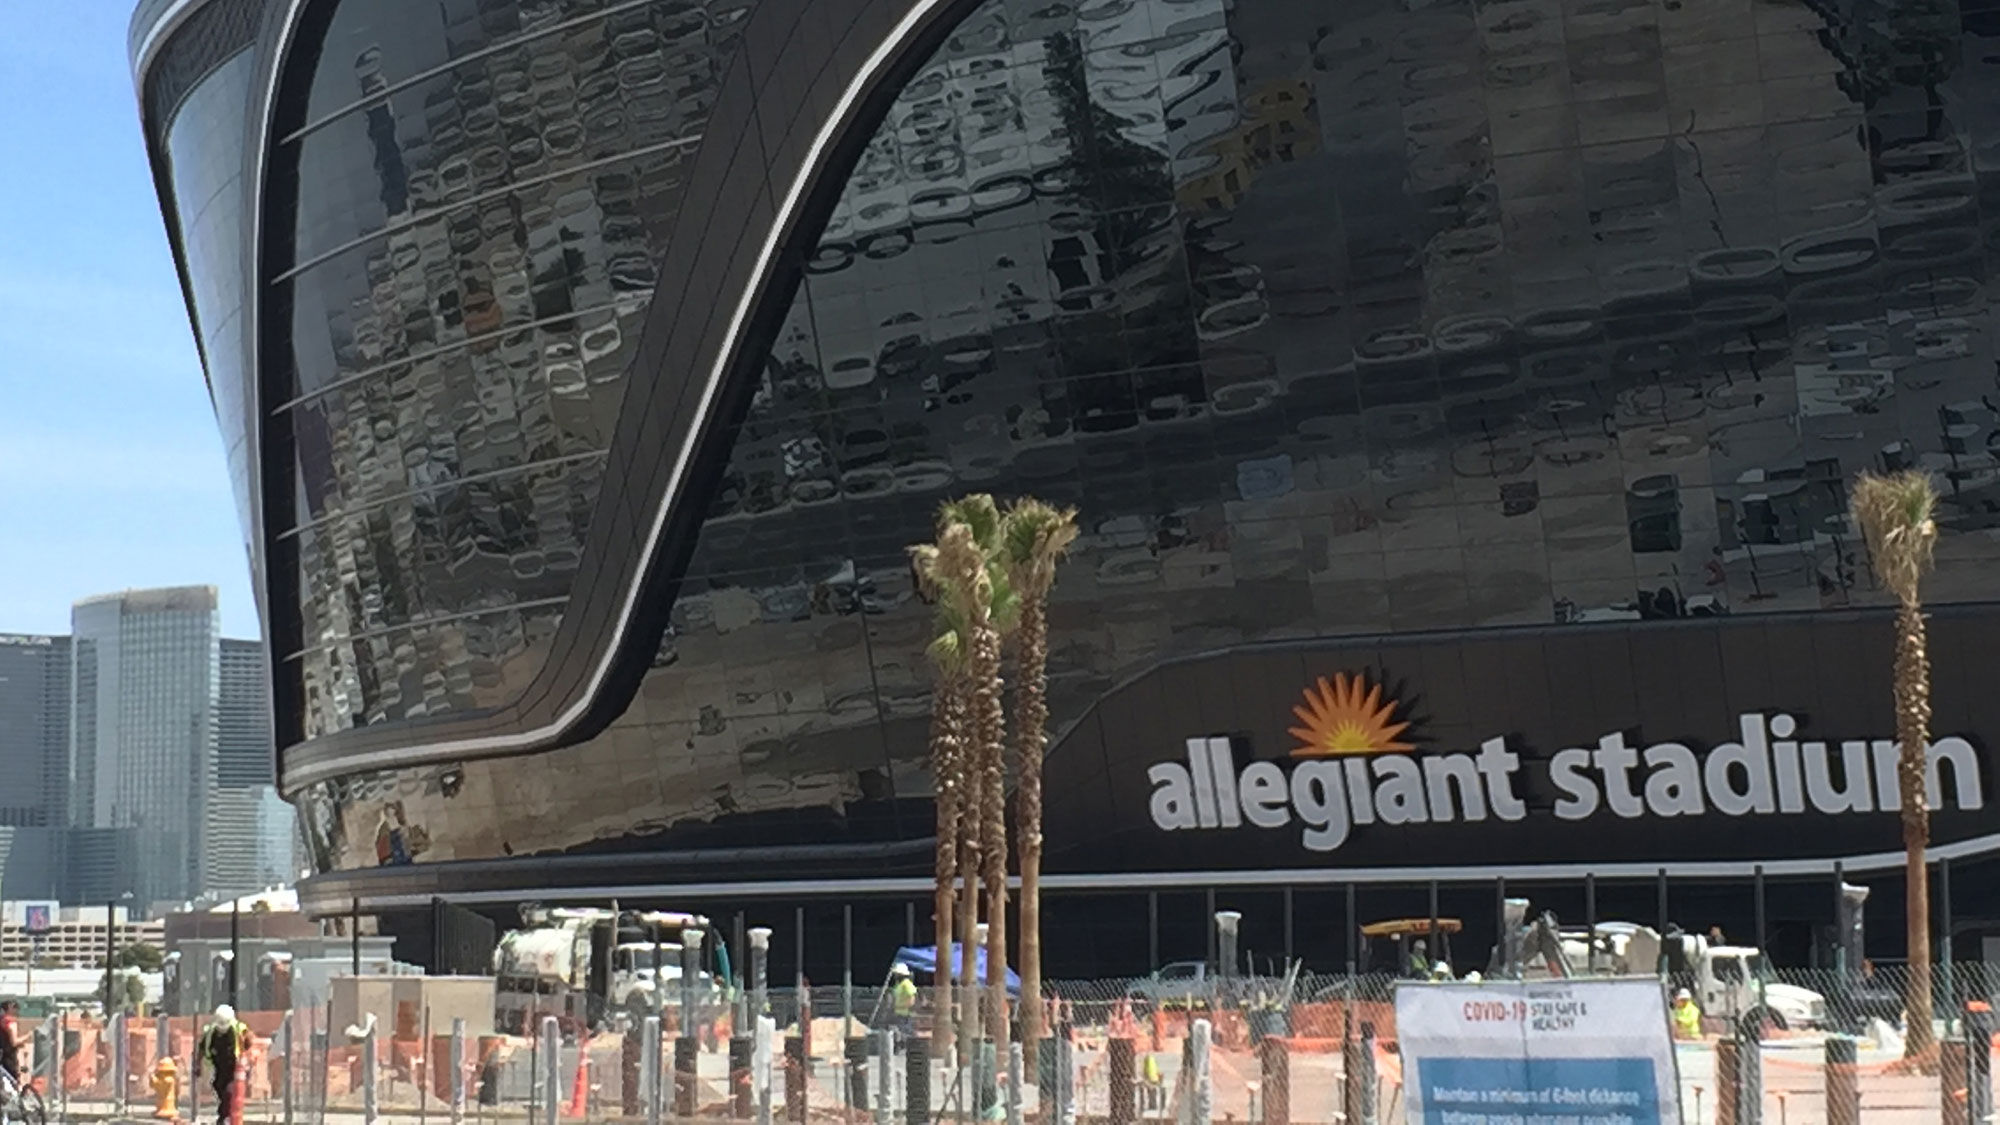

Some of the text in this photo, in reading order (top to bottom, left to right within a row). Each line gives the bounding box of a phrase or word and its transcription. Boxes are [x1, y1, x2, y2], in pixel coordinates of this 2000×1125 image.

[1147, 713, 1983, 852] allegiant stadium
[1463, 1001, 1527, 1021] COVID-19
